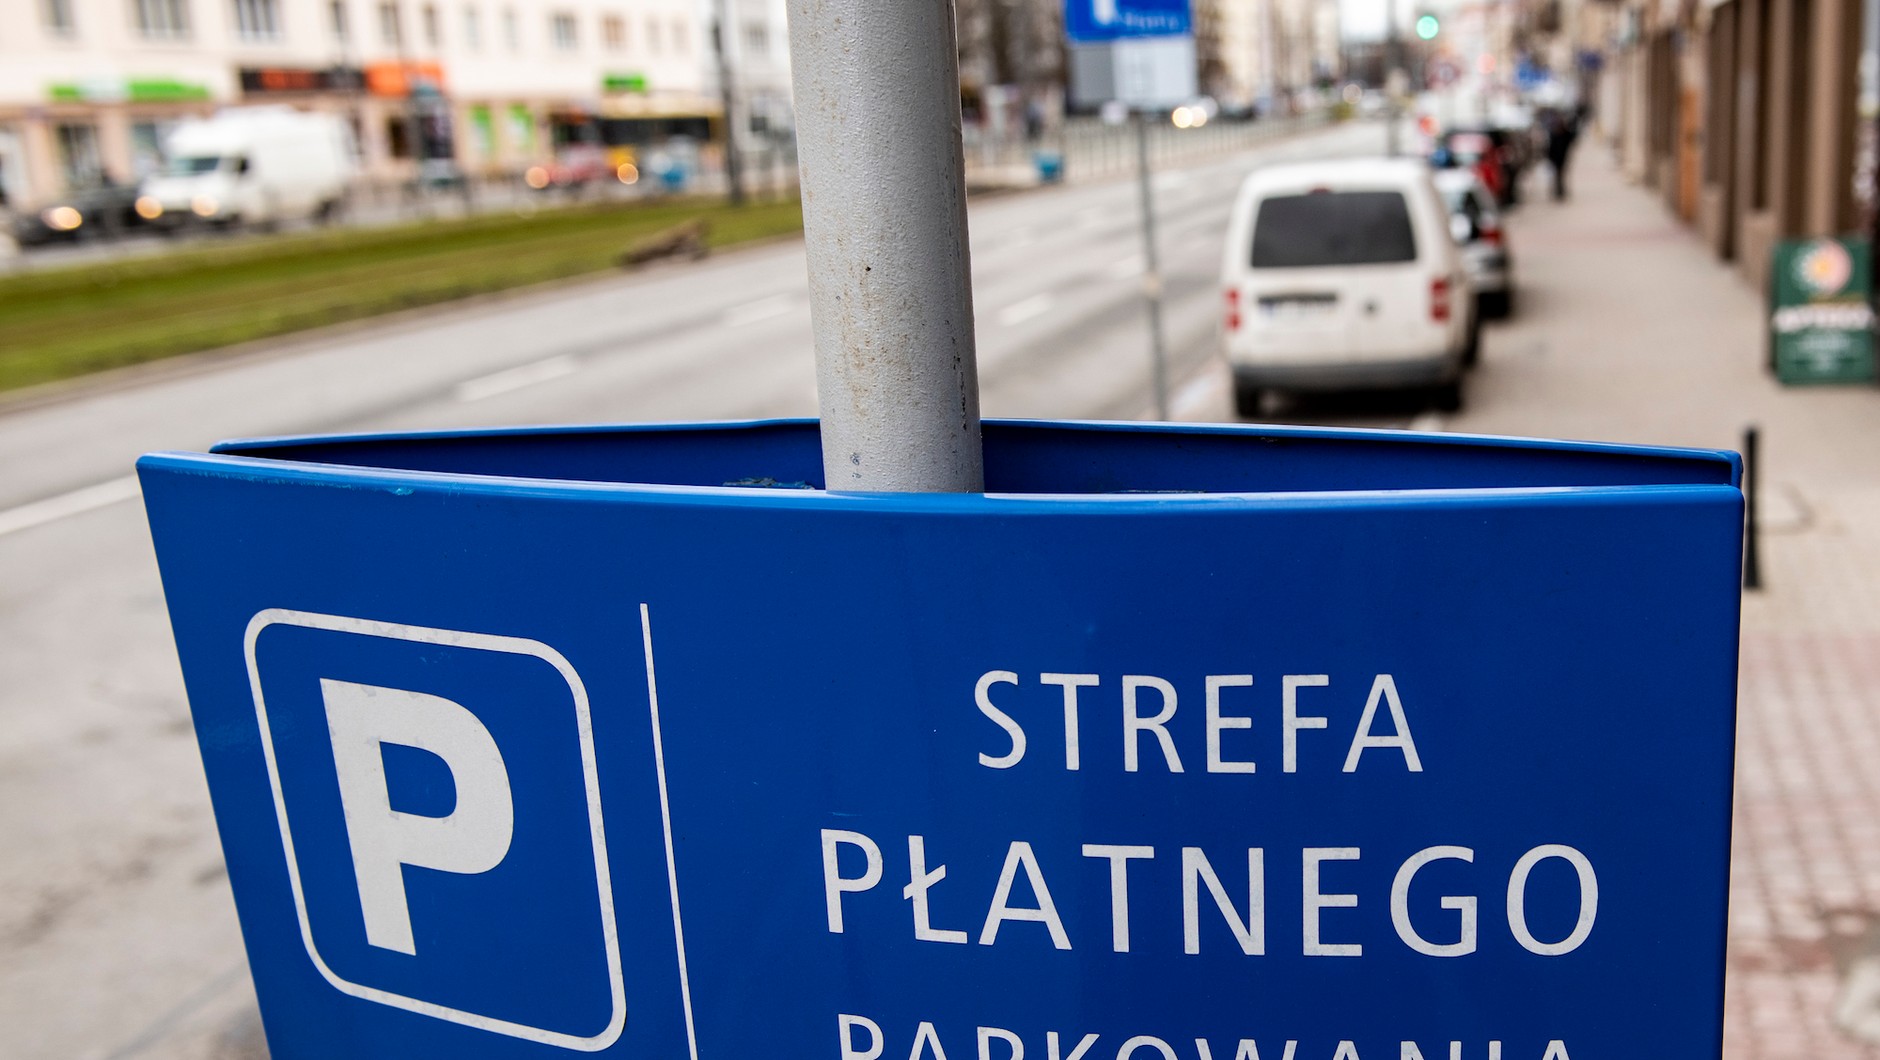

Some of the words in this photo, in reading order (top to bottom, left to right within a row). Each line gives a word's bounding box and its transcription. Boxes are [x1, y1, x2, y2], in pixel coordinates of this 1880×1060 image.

[973, 670, 1424, 774] STREFA
[319, 677, 514, 956] P
[820, 828, 1600, 957] PŁATNEGO
